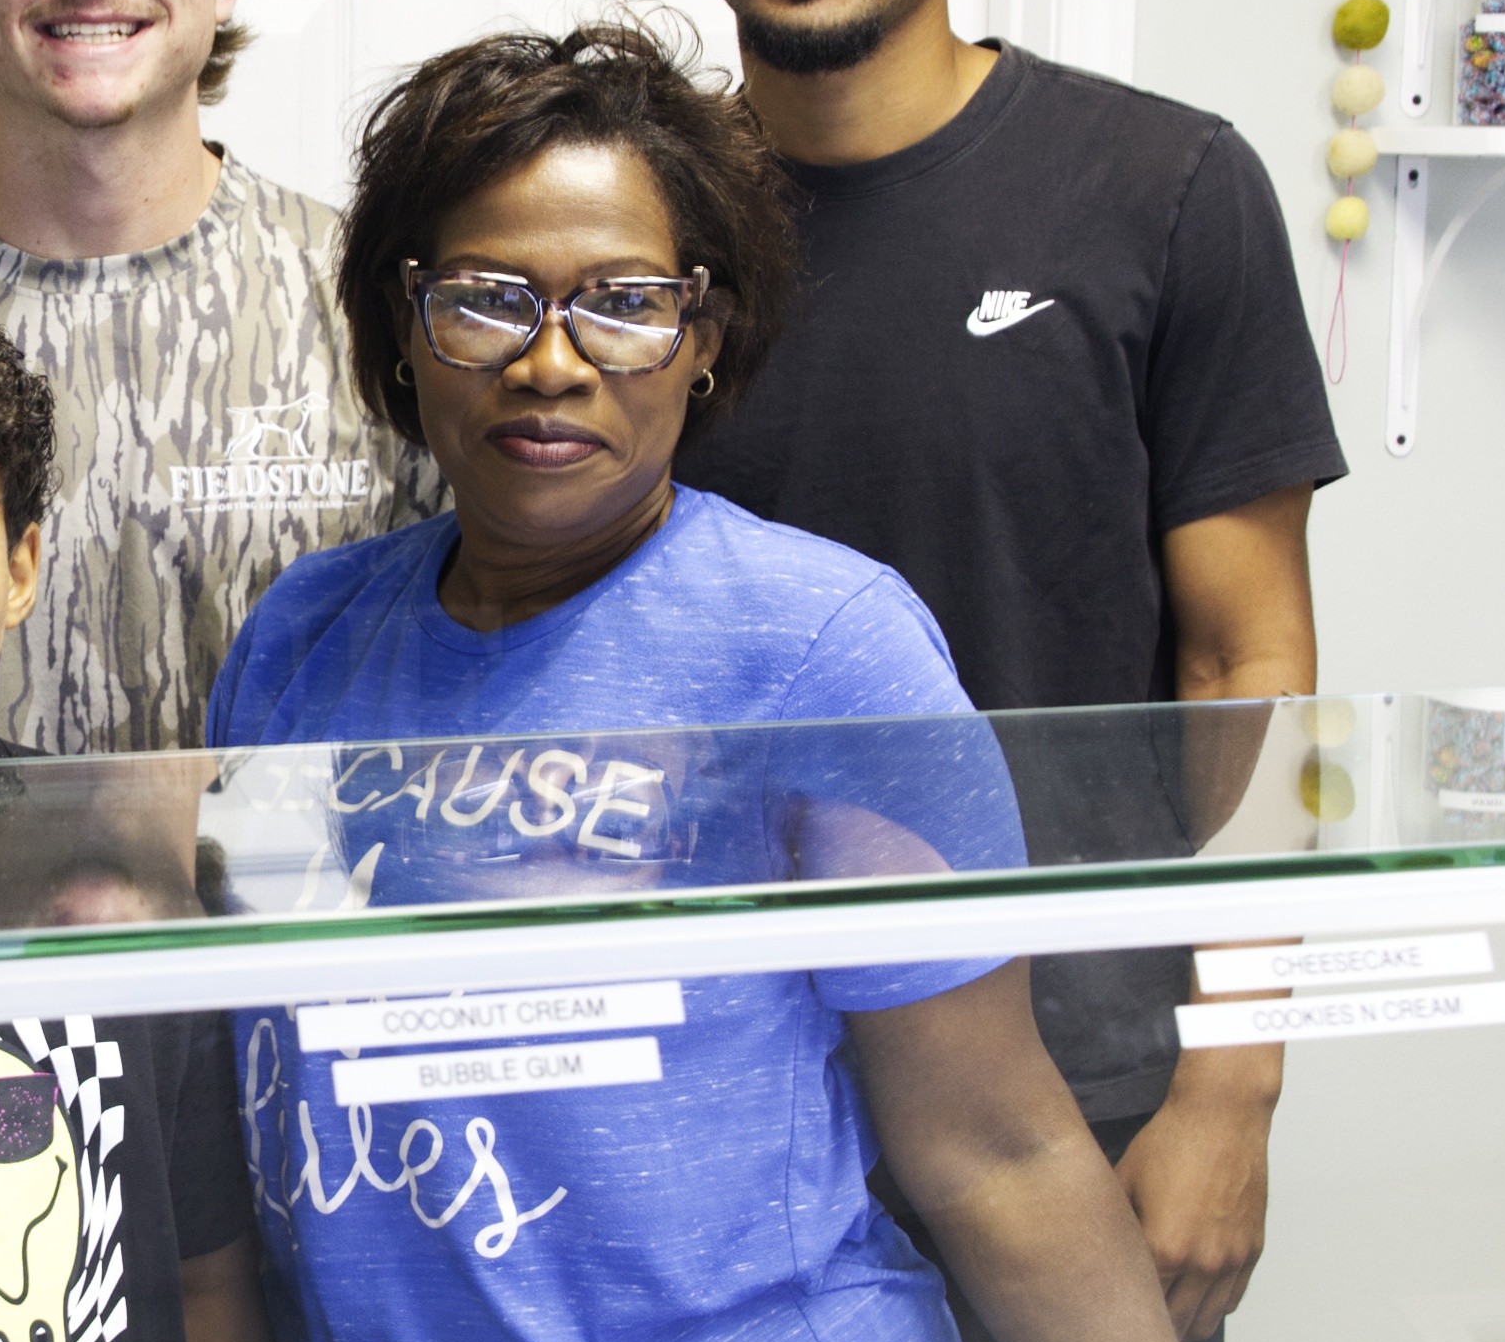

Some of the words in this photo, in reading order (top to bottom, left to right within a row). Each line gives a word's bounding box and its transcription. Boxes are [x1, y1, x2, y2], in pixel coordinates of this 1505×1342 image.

[169, 459, 370, 501] FIELDSTONE
[1271, 946, 1423, 978] CHEESECAKE
[383, 1004, 508, 1034] COCONUT
[515, 996, 607, 1023] CREAM
[1253, 1005, 1355, 1032] COOKIES
[1361, 1004, 1376, 1022] N
[1382, 997, 1463, 1020] CREAM
[420, 1058, 517, 1088] BUBBLE
[527, 1054, 583, 1080] GUM
